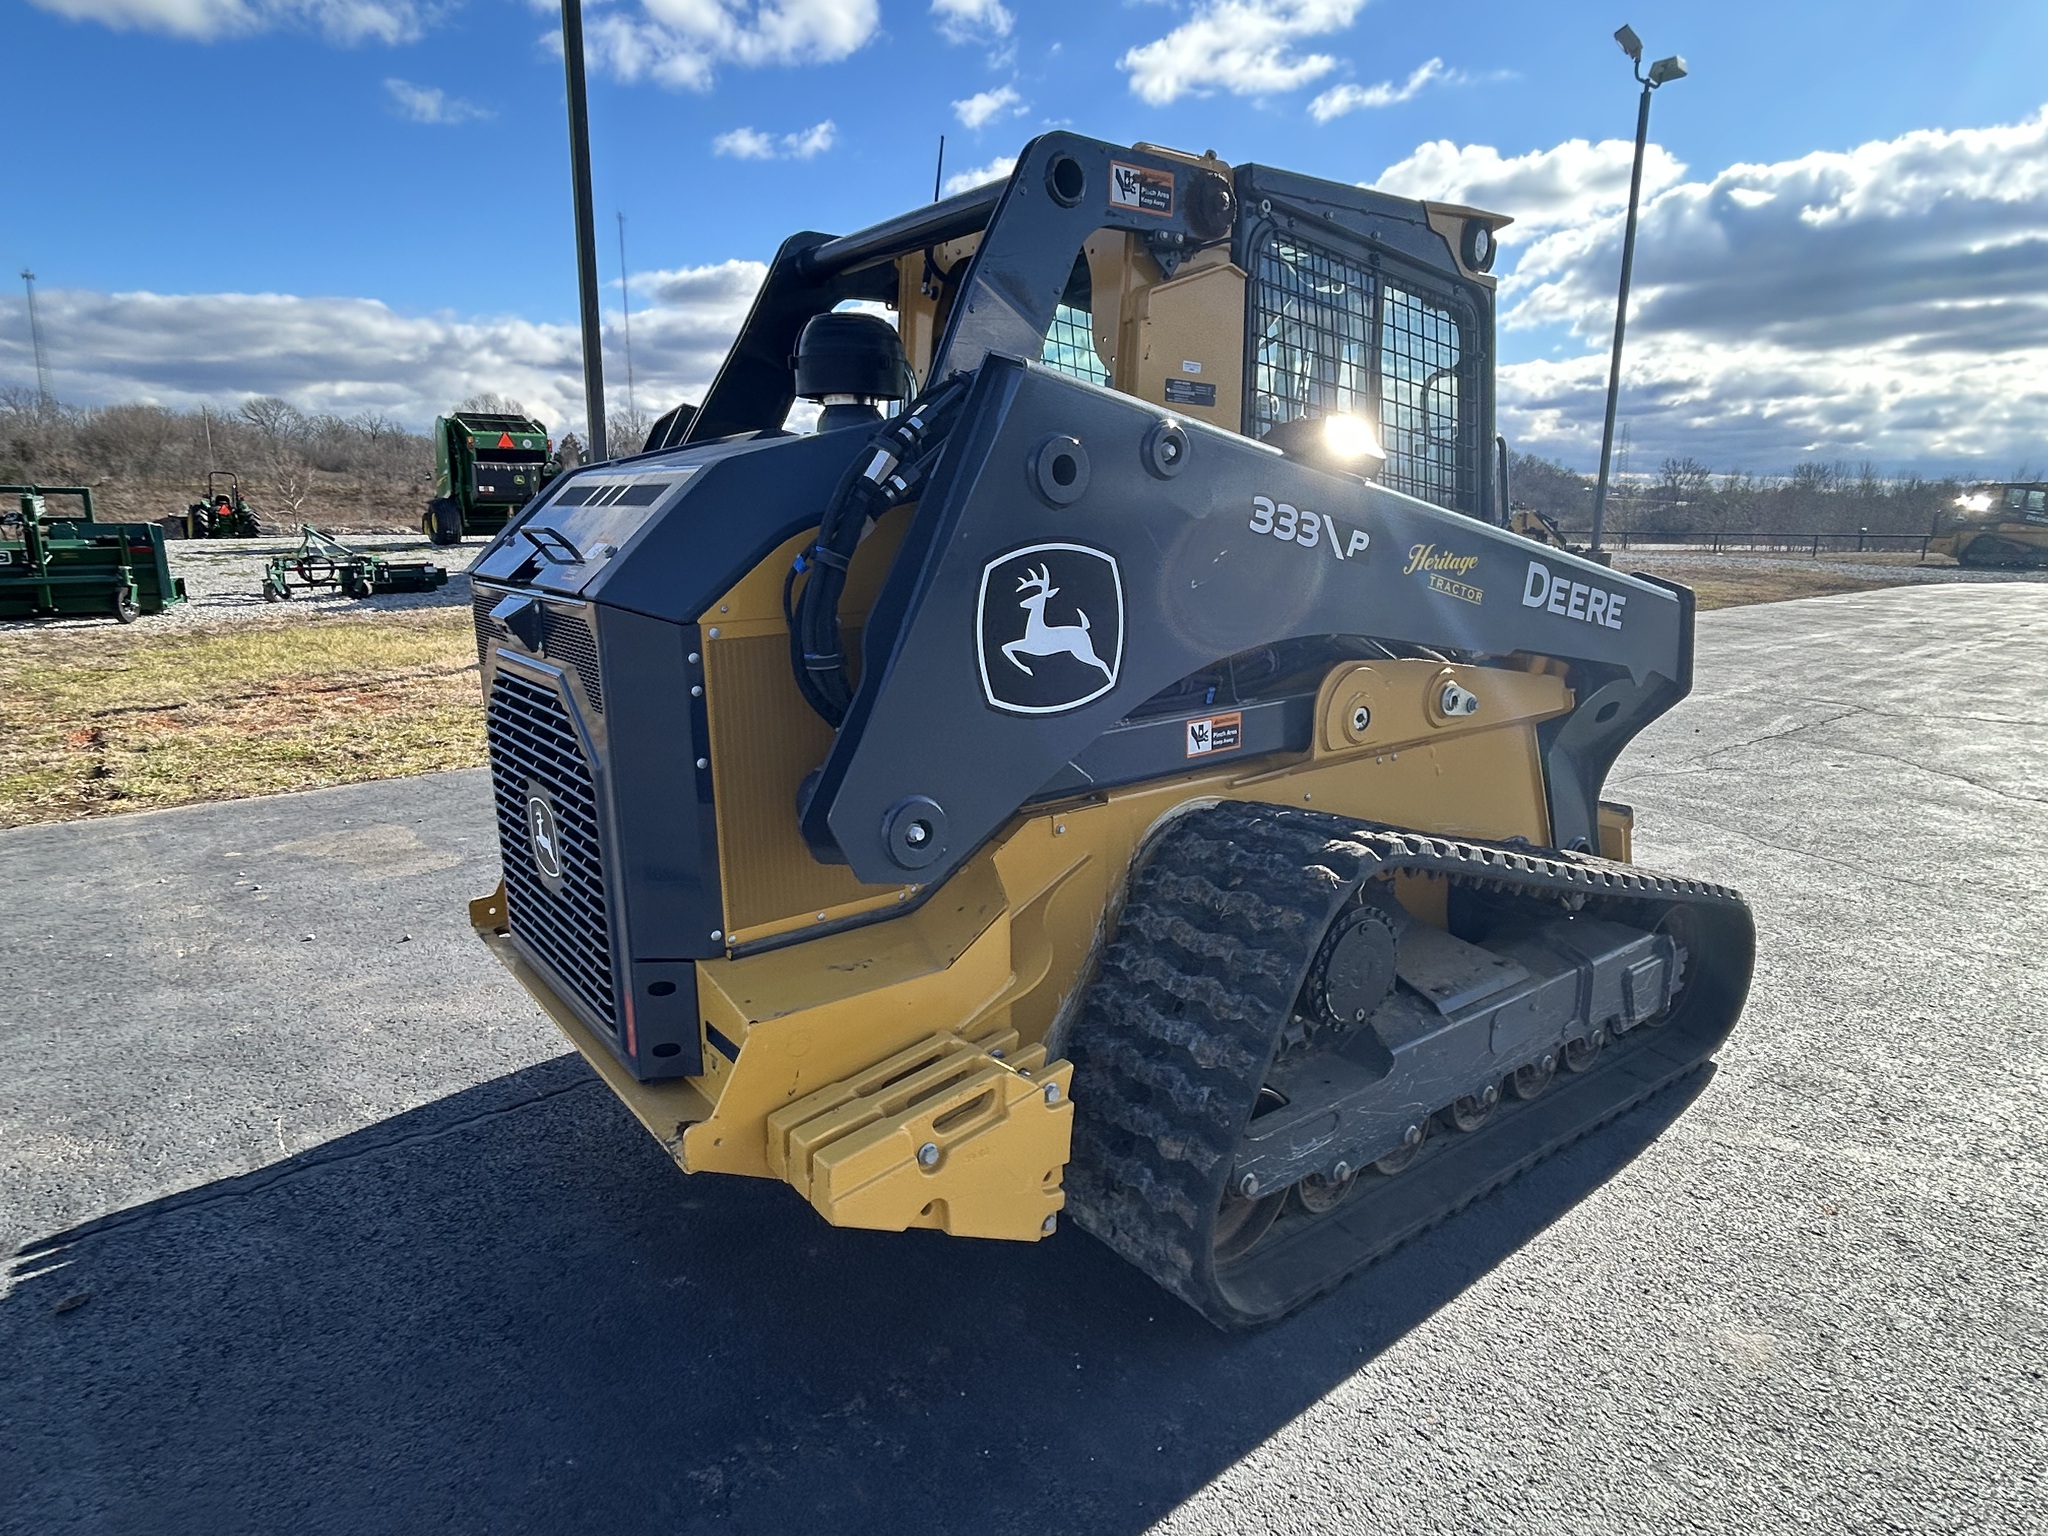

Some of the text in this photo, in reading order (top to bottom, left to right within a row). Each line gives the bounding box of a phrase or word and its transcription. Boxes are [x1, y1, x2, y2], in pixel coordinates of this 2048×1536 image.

[1403, 544, 1478, 576] Heritage
[1429, 575, 1483, 602] TRACTOR
[1522, 561, 1627, 630] DEERE
